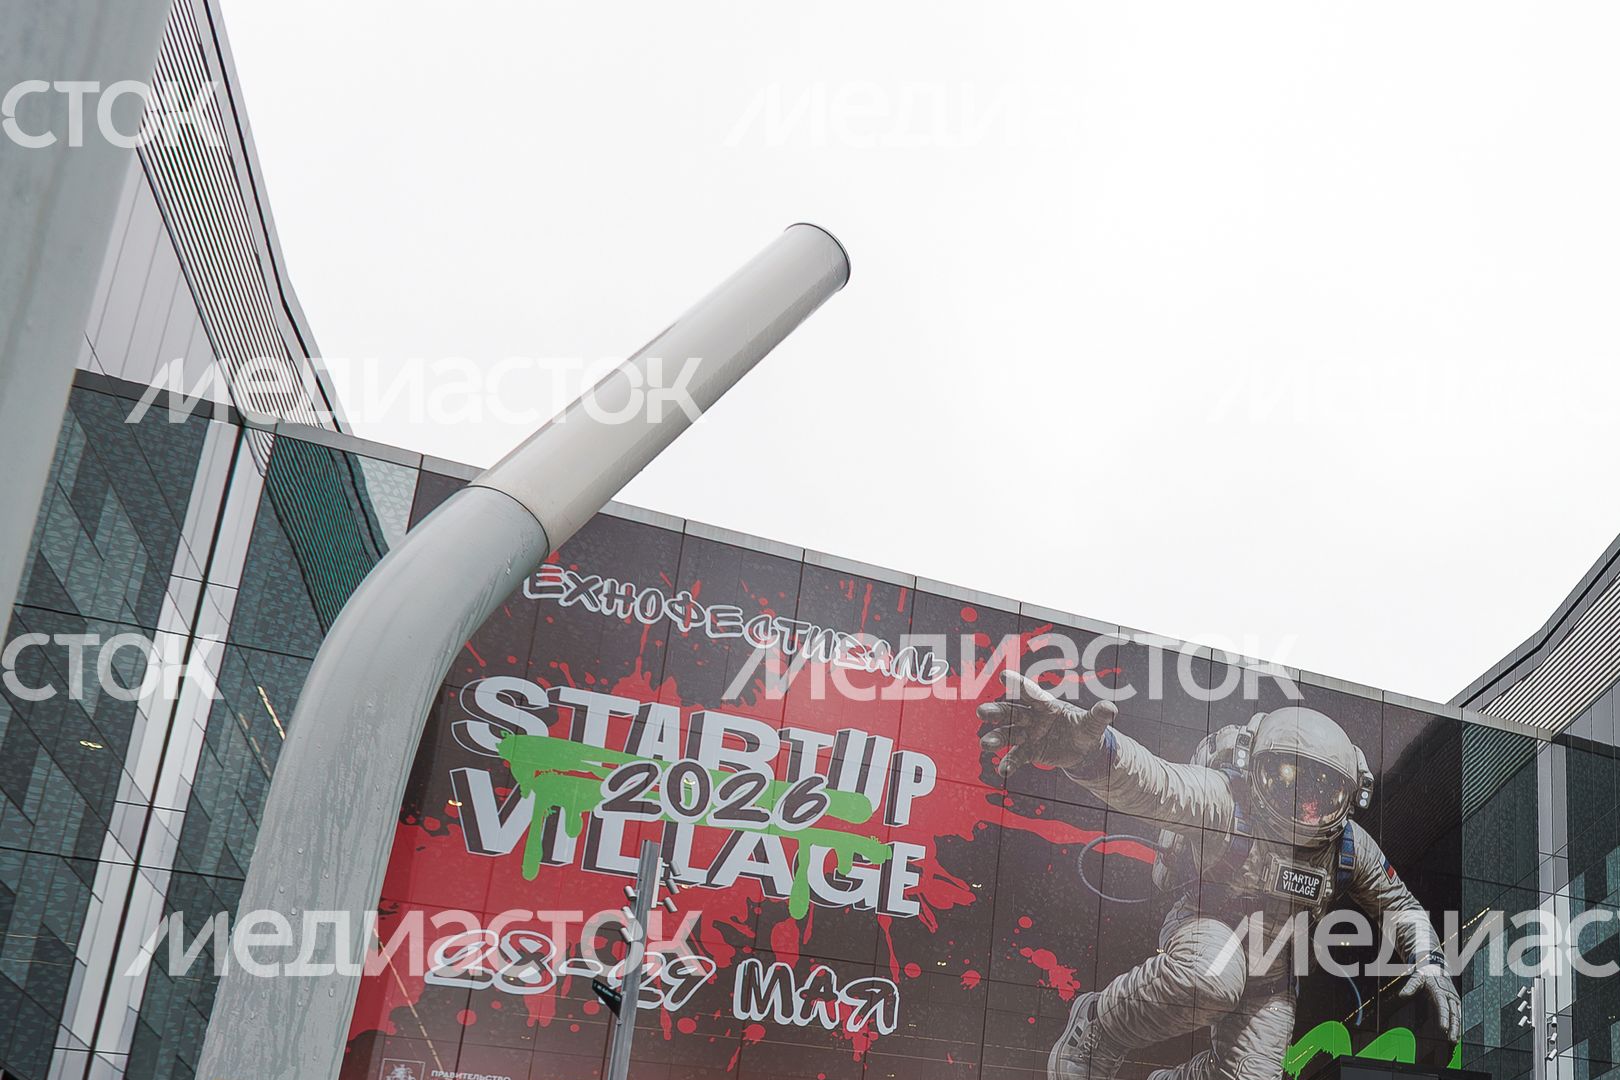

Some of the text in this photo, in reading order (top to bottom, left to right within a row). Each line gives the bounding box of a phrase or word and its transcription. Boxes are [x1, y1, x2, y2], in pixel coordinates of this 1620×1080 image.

[523, 564, 950, 685] ЕХНОФЕСТИВАЛЬ
[451, 676, 937, 828] STARTUP
[597, 759, 832, 830] 2026
[450, 767, 927, 918] VILLAGE
[1282, 870, 1320, 887] STARTUP
[1282, 880, 1316, 897] VILLAGE
[733, 958, 900, 1035] МАЯ
